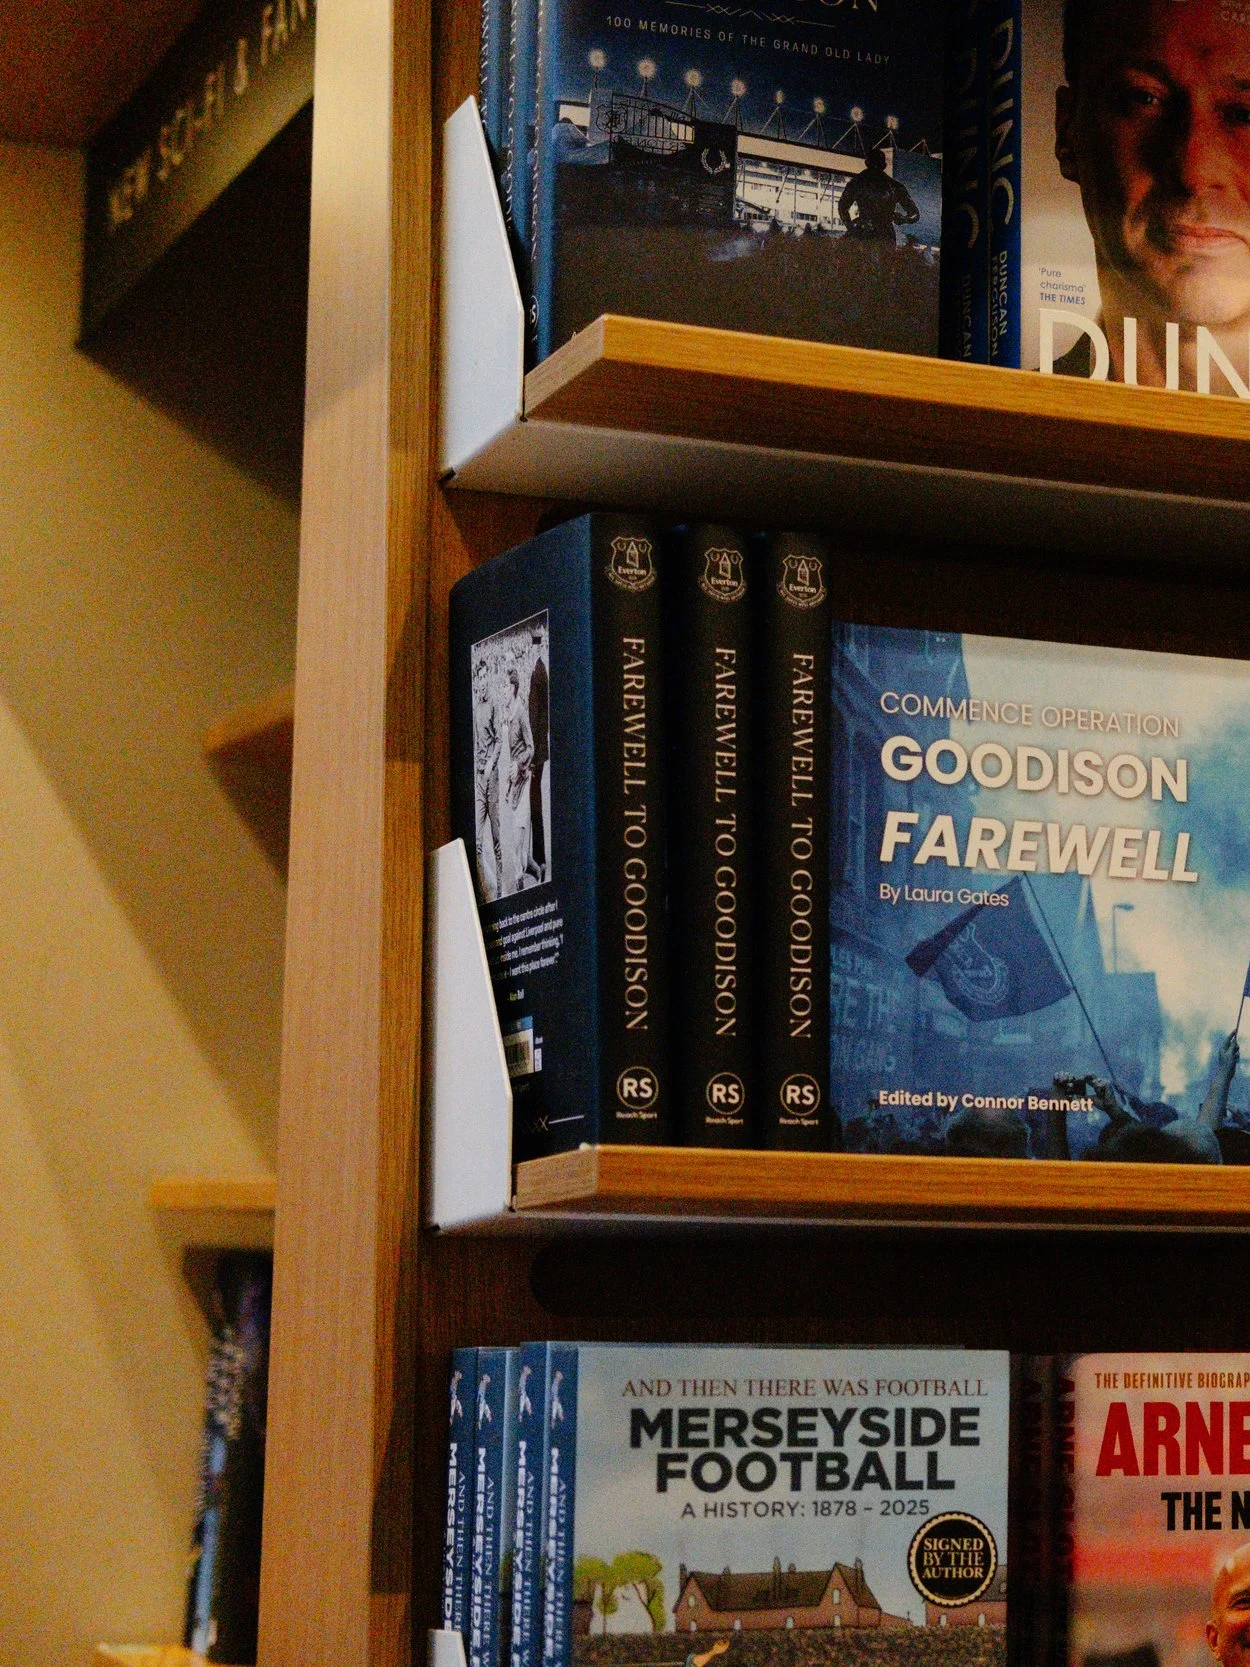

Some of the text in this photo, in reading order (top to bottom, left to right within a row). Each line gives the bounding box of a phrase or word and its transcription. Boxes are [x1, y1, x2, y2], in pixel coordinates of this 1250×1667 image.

[607, 15, 890, 64] 100 MEMORIES OF THE GRAND OLD LADY
[998, 250, 1008, 336] DUNCAN
[1040, 292, 1086, 306] THE TIMES
[617, 567, 647, 575] Everton
[710, 576, 738, 587] Everton
[788, 584, 817, 594] Everton
[880, 691, 1180, 738] COMMENCE OPERATION
[881, 735, 1187, 802] GOODISON
[622, 636, 648, 1031] FAREWELL TO GOODISON
[714, 647, 737, 1037] FAREWELL TO GOODISON
[789, 653, 814, 1039] FAREWELL TO GOODISON
[880, 810, 1197, 883] FAREWELL
[880, 883, 1009, 907] By Laura Gates
[622, 1077, 653, 1098] RS
[712, 1083, 740, 1104] RS
[785, 1083, 815, 1105] RS
[879, 1090, 1093, 1111] Edited by Connor Bennett
[622, 1379, 988, 1397] AND THEN THERE WAS FOOTBALL
[1095, 1372, 1119, 1389] THE
[1123, 1372, 1193, 1389] DEFINITIVE
[630, 1407, 980, 1449] MERSEYSIDE
[656, 1450, 955, 1493] FOOTBALL
[681, 1500, 930, 1519] A HISTORY: 1878 2025
[1161, 1491, 1221, 1531] THE
[470, 1448, 486, 1648] MERSEYSIDE
[513, 1441, 526, 1645] MERSEYSIDE
[923, 1537, 984, 1552] SIGNED
[923, 1551, 984, 1566] BY THE
[922, 1565, 984, 1580] AUTHOR
